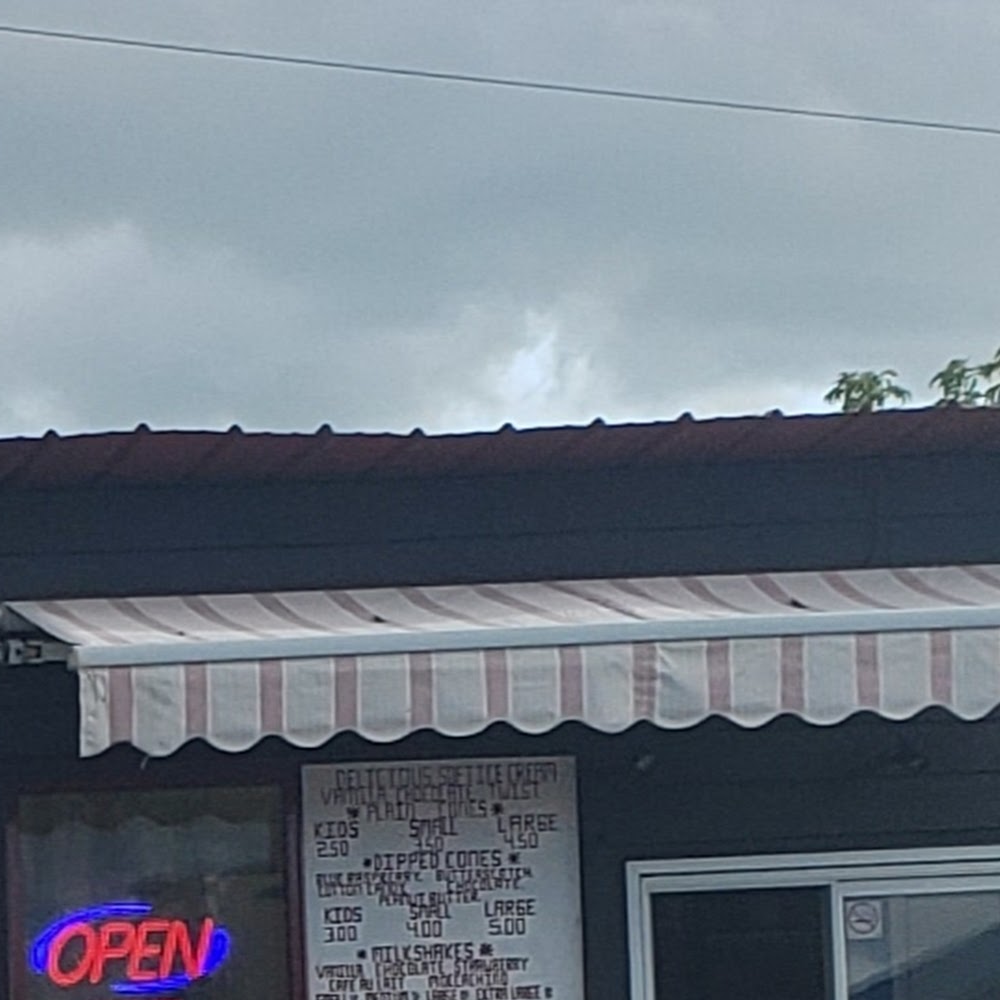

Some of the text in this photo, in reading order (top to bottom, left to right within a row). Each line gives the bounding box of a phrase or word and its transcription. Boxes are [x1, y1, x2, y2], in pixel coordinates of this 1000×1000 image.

[314, 814, 558, 839] KIDS SMALL LARGE
[374, 849, 502, 871] DIPPED CONES
[324, 906, 363, 924] KIDS
[484, 898, 537, 917] LARGE
[47, 916, 214, 987] OPEN
[371, 942, 475, 963] MILKSHAKES
